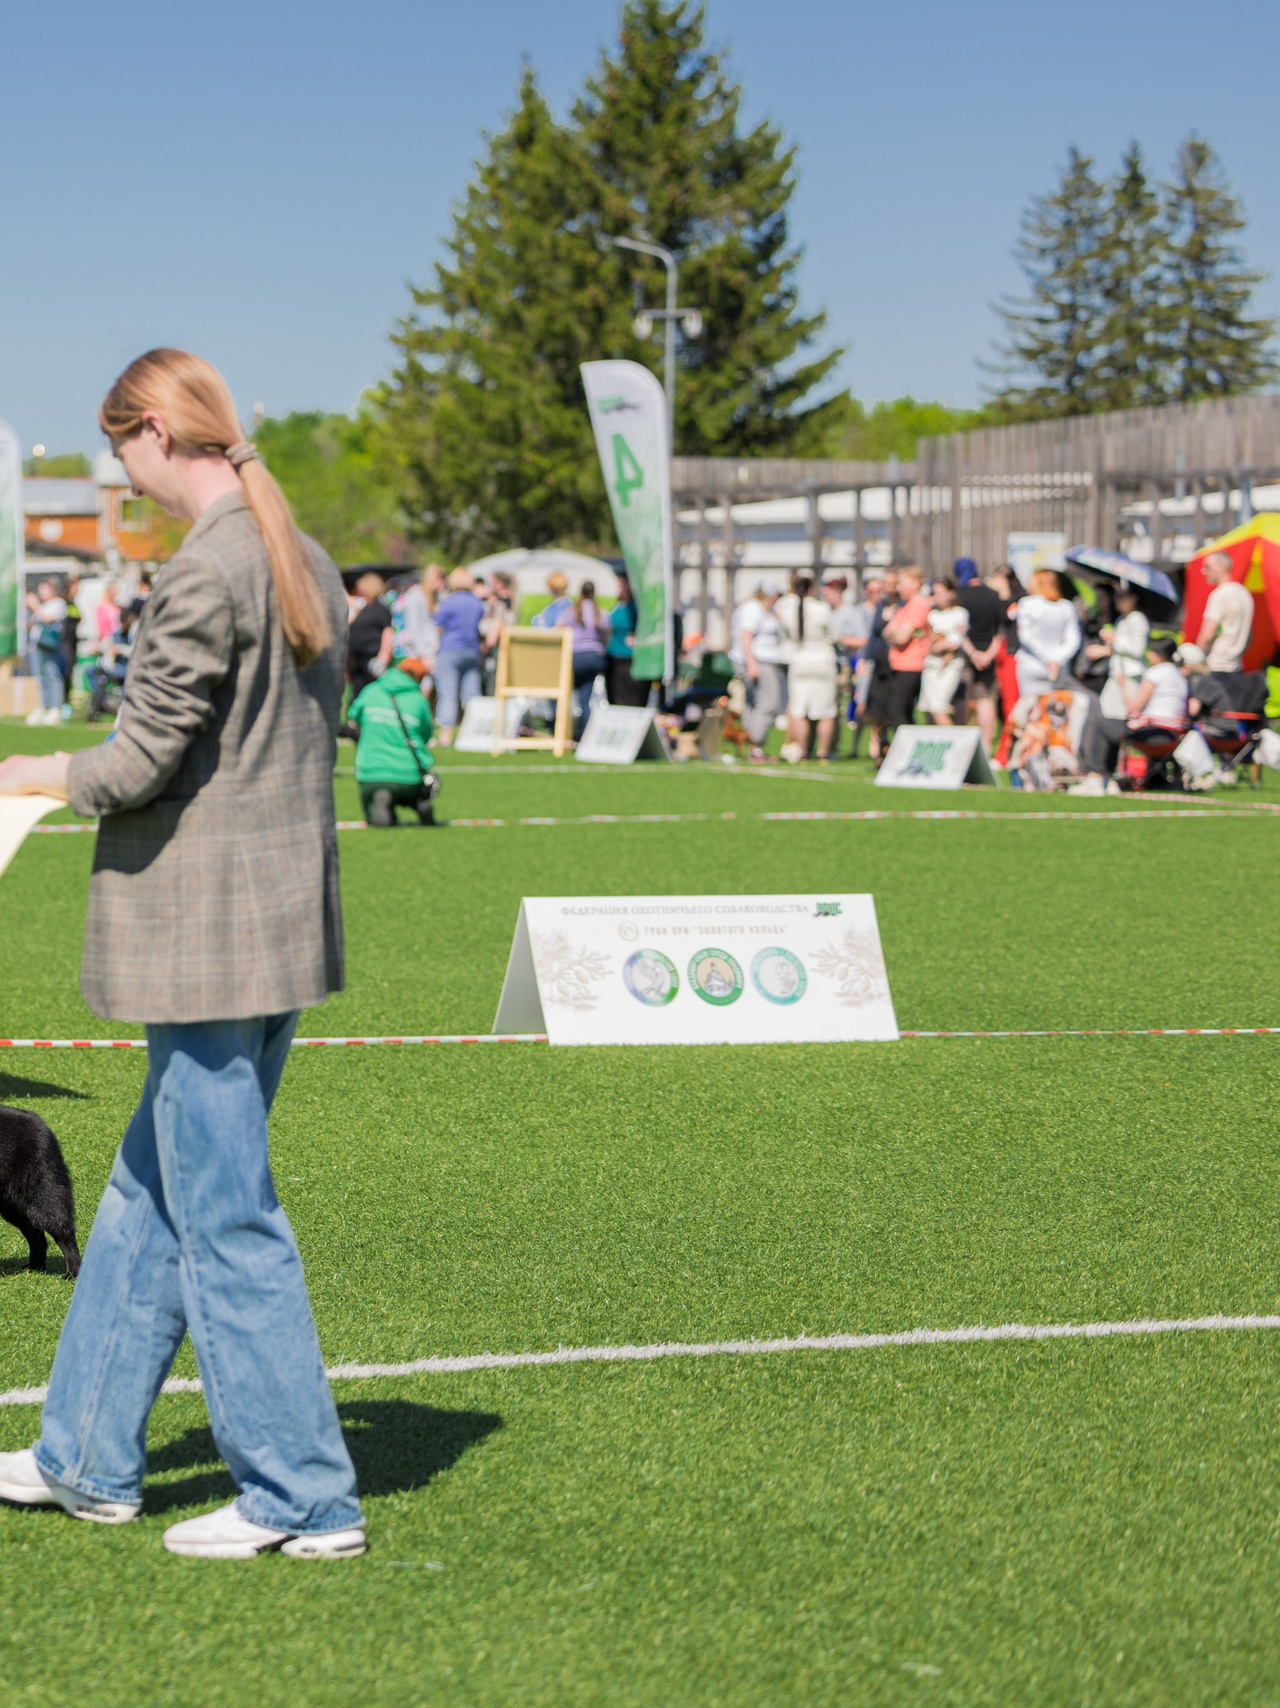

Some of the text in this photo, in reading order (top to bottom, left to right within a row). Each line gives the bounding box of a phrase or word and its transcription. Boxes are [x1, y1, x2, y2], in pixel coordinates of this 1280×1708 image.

[560, 903, 809, 916] ФЕДЕРАЦИЯ ОХОТНИЧЬЕГО СОБАКОВОДСТВА
